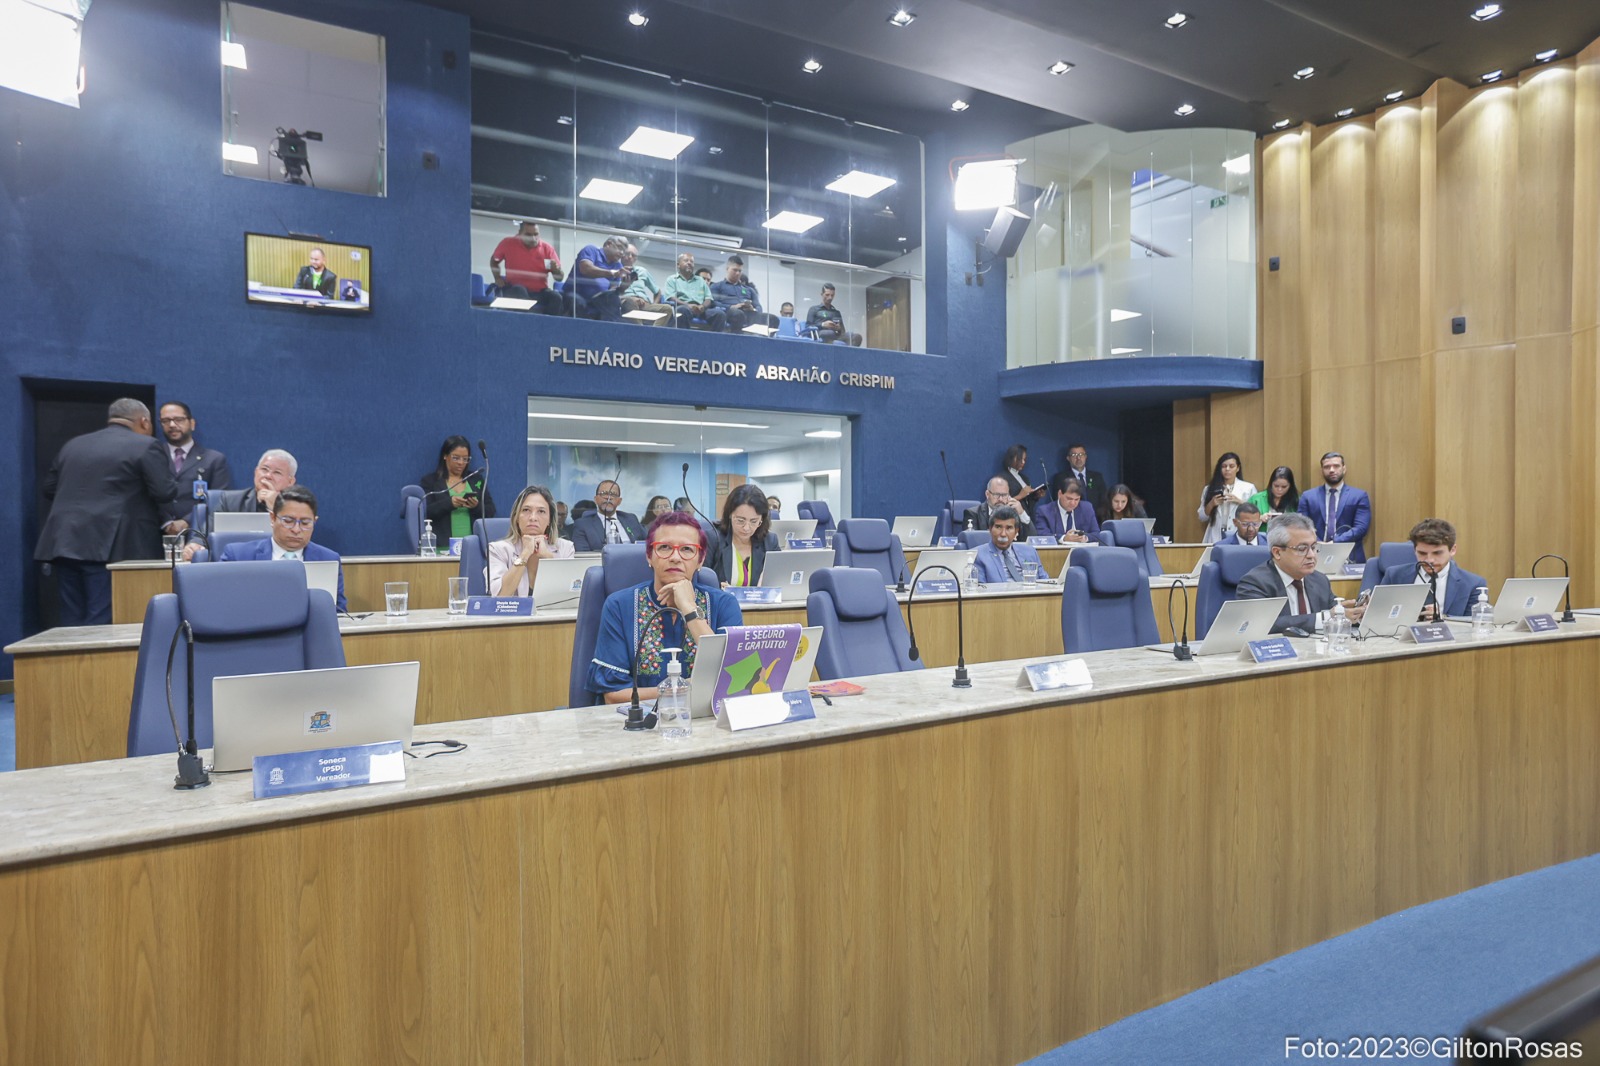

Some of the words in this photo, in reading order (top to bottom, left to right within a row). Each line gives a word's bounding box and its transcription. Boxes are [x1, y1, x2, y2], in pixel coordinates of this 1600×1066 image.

[549, 346, 643, 369] PLENÁRIO
[654, 356, 747, 378] VEREADOR
[756, 366, 832, 384] ABRAHÃO
[839, 372, 895, 389] CRISPIM
[752, 629, 785, 640] SEGURO
[736, 642, 743, 651] E
[744, 640, 788, 651] GRATUITO!
[318, 757, 346, 766] Soneca
[322, 765, 343, 773] (PSD)
[316, 773, 350, 782] Vereador
